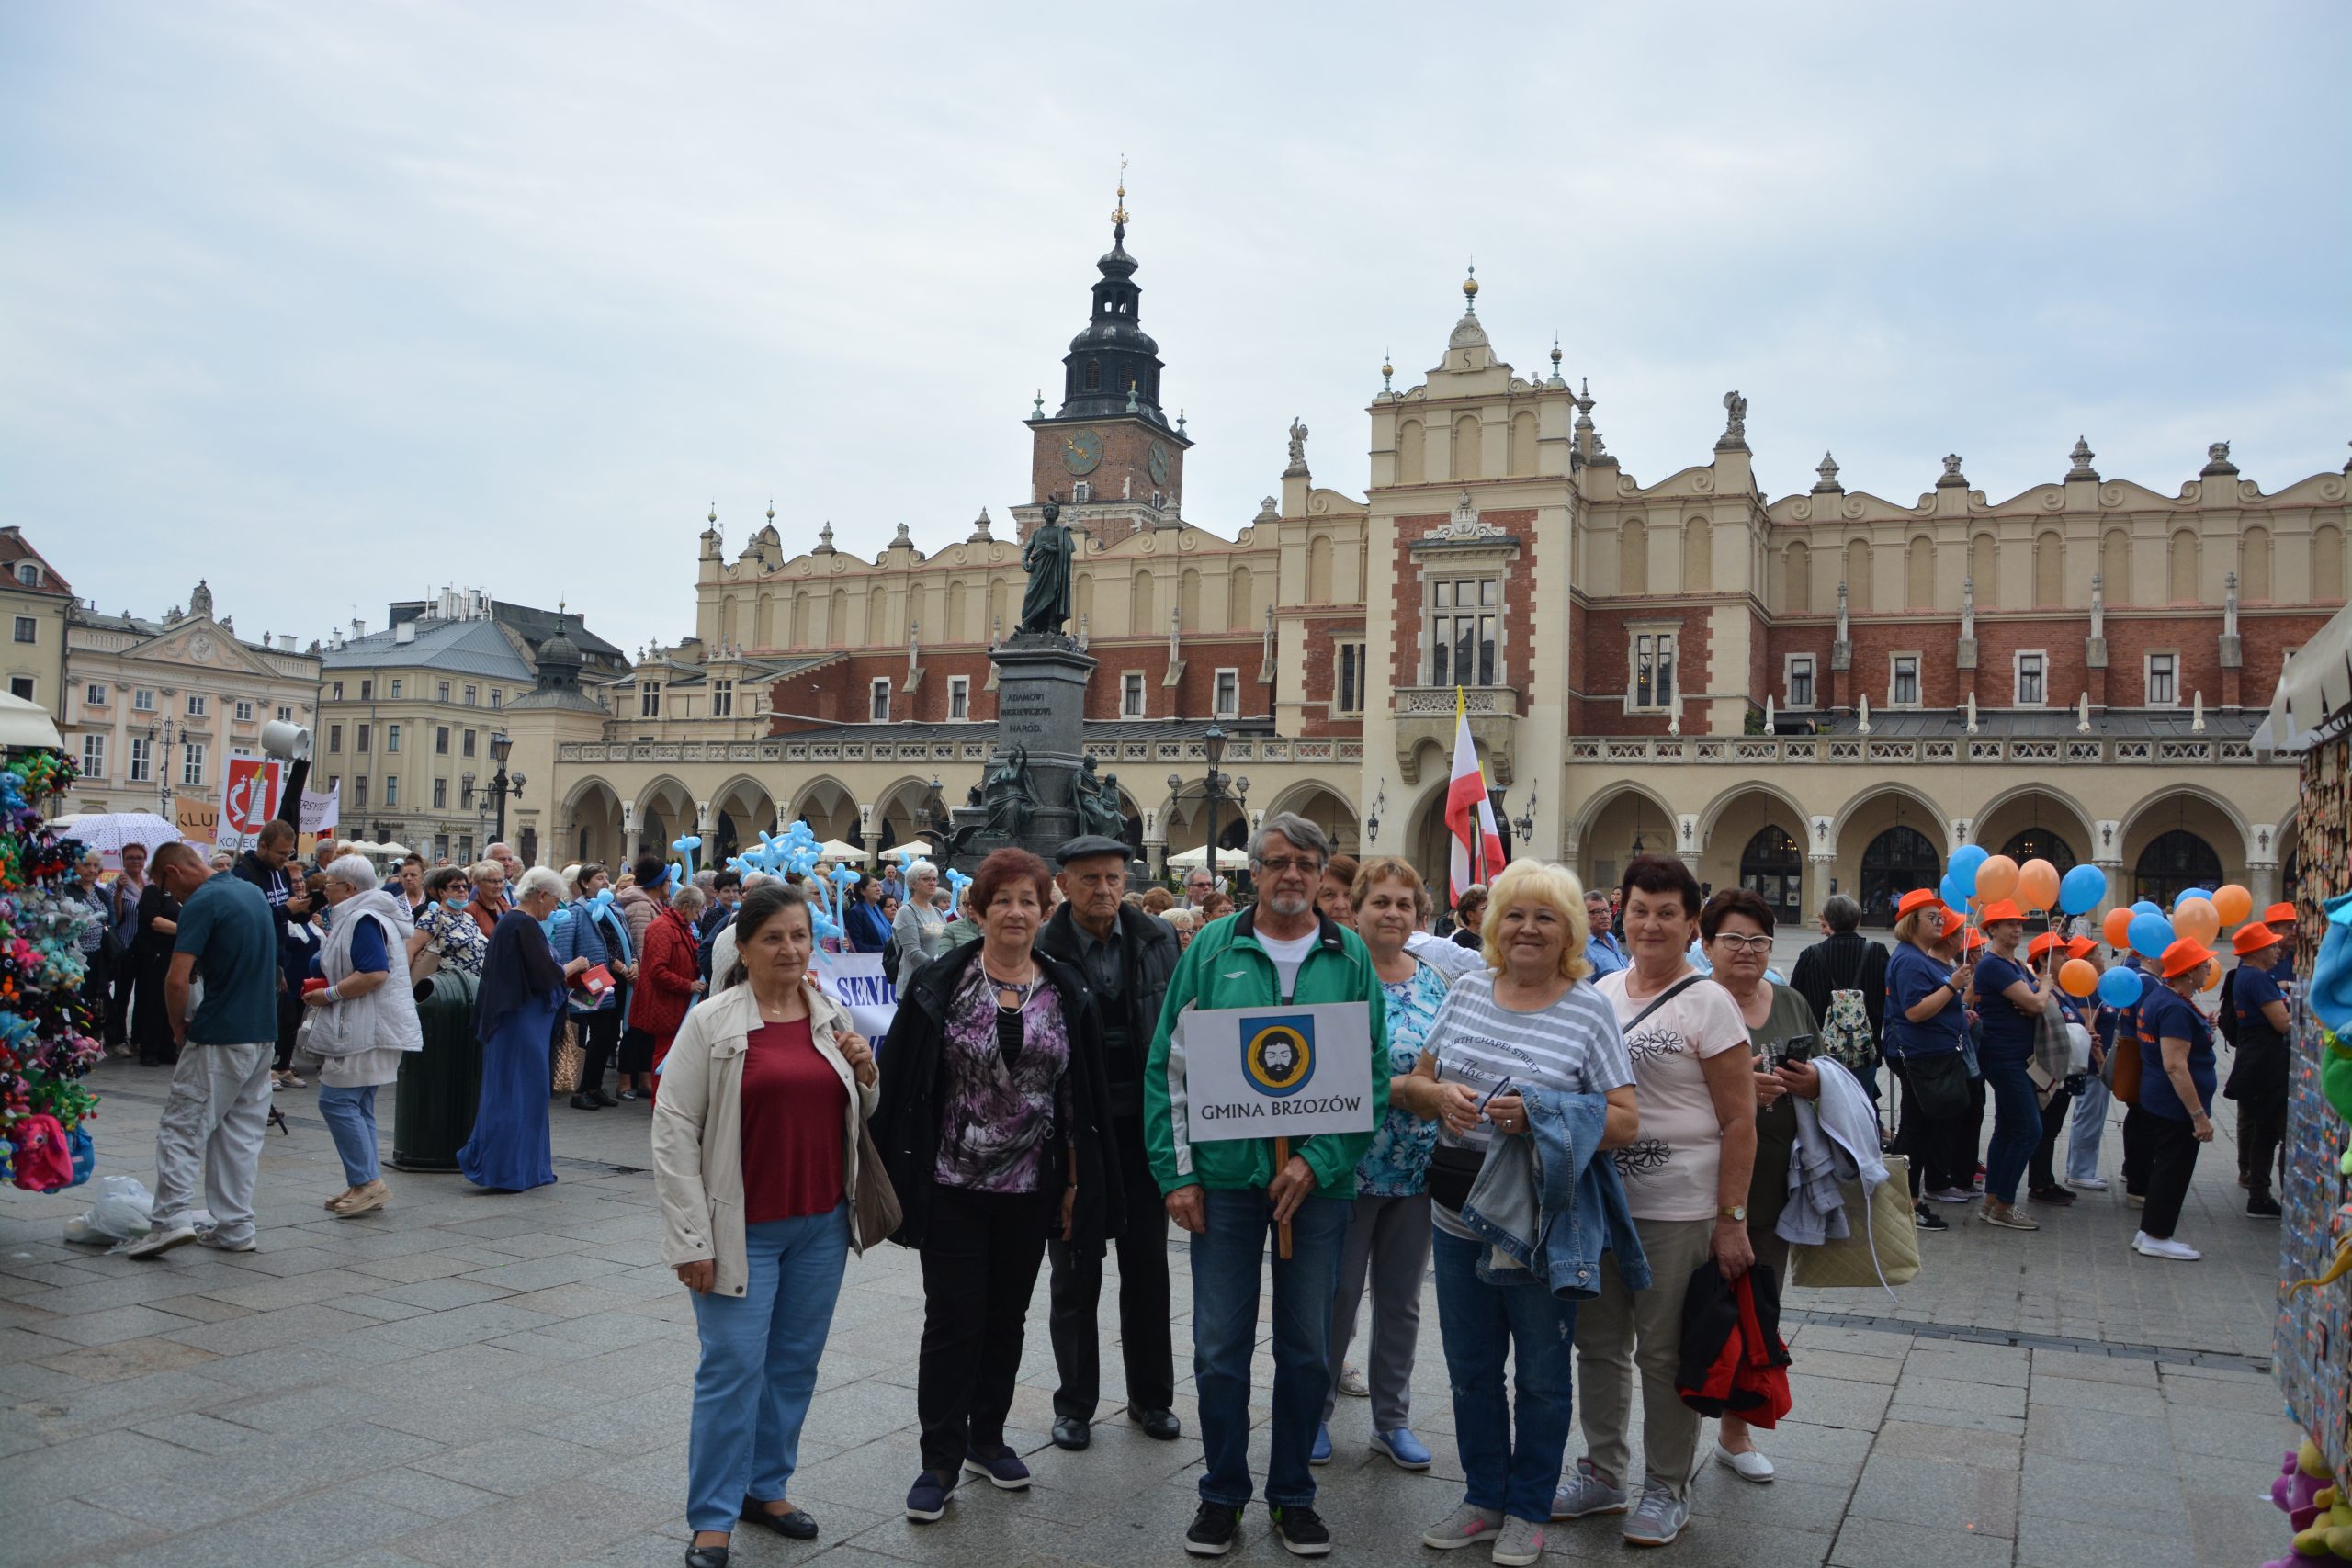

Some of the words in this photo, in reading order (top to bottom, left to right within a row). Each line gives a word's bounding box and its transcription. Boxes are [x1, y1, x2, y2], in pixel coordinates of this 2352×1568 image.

[1007, 693, 1045, 702] ADAMOWI
[1444, 1036, 1474, 1050] ORTH
[1475, 1036, 1511, 1053] CHAPEL
[1511, 1048, 1543, 1075] STREET
[1459, 1057, 1485, 1081] The
[1201, 1103, 1265, 1121] GMINA
[1272, 1095, 1362, 1117] BRZOZÓW
